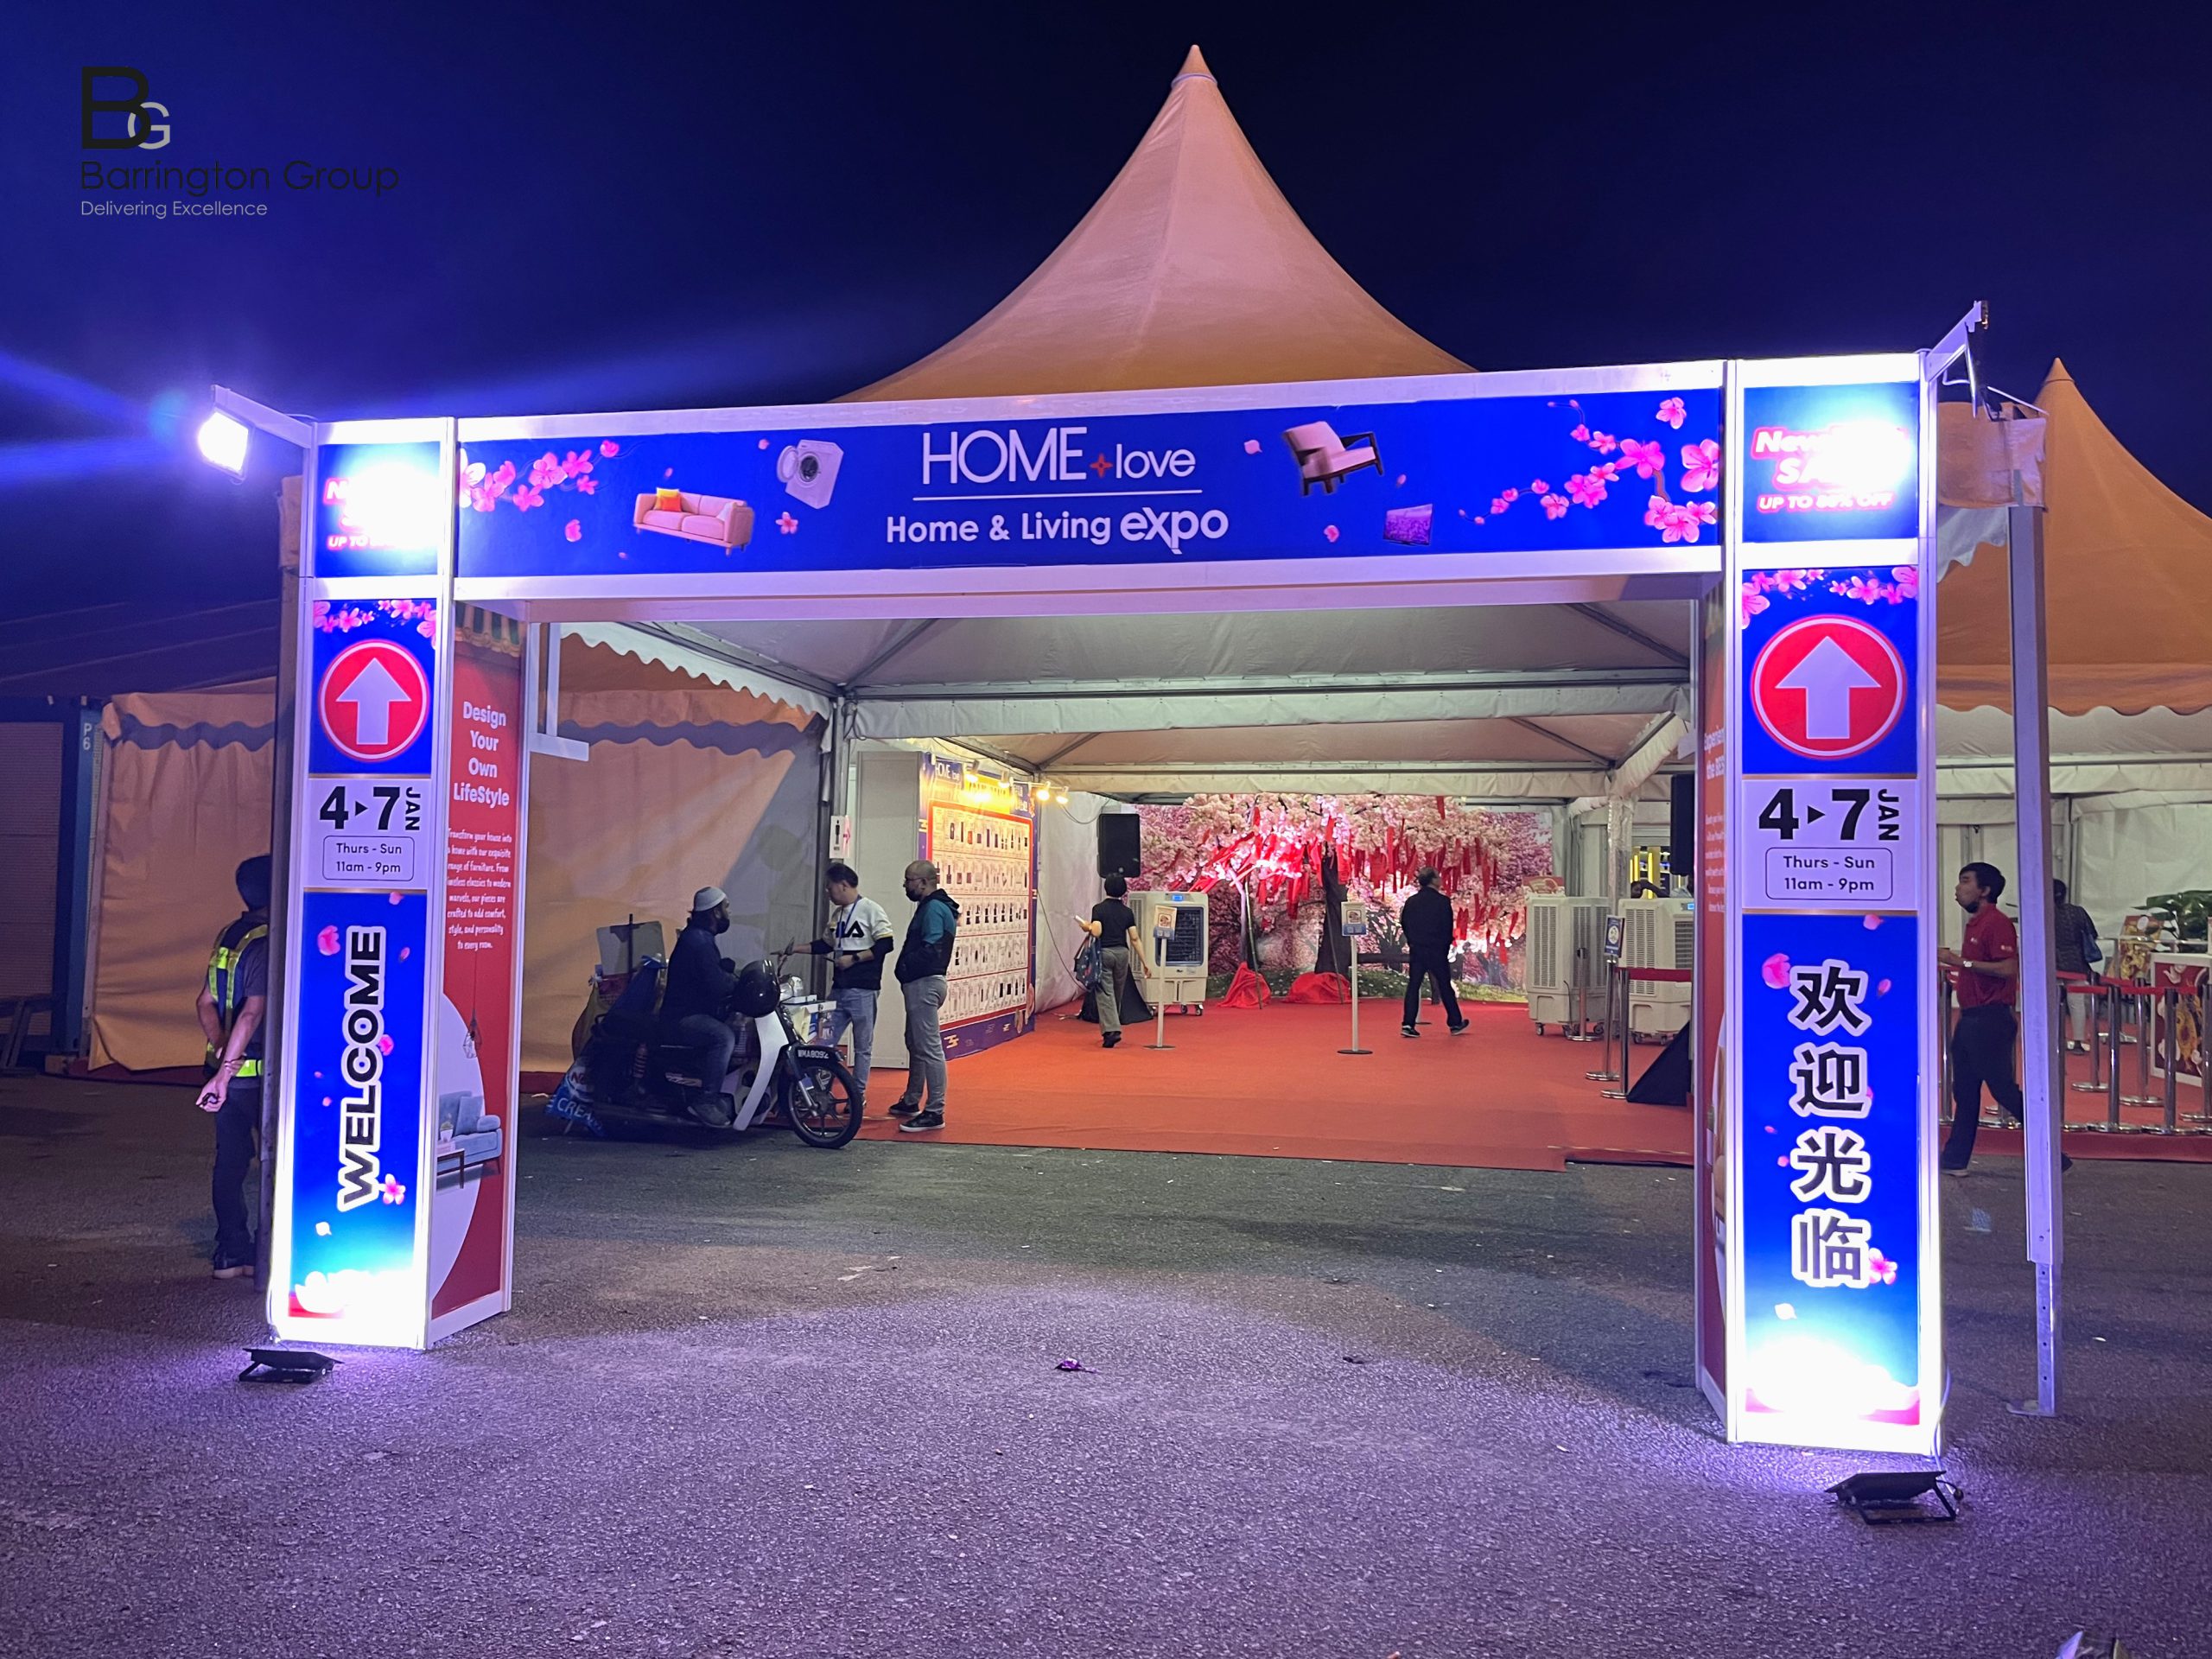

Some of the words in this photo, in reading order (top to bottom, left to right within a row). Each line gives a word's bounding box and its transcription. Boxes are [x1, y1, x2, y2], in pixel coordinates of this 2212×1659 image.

[922, 426, 1087, 485] HOME
[1116, 443, 1196, 479] love
[1759, 496, 1784, 509] UP
[1789, 495, 1813, 508] TO
[1857, 493, 1892, 507] OFF
[328, 536, 347, 547] UP
[350, 535, 368, 546] TO
[887, 516, 979, 543] Home
[989, 515, 1010, 541] &
[1021, 511, 1111, 545] Living
[1120, 507, 1229, 555] expo
[463, 701, 506, 729] Design
[470, 730, 499, 752] Your
[468, 757, 498, 778] Own
[320, 785, 349, 830] 4
[372, 786, 400, 830] 7
[404, 787, 421, 830] JAN
[454, 782, 510, 809] LifeStyle
[1758, 788, 1799, 840] 4
[1831, 788, 1870, 841] 7
[1878, 788, 1899, 841] JAN
[336, 842, 369, 855] Thurs
[380, 843, 402, 855] Sun
[336, 861, 364, 872] 11am
[375, 862, 401, 875] 9pm
[1783, 855, 1828, 868] Thurs
[1844, 855, 1875, 868] Sun
[1784, 877, 1823, 890] 11am
[1839, 878, 1874, 893] 9pm
[340, 928, 384, 1208] WELCOME
[1793, 963, 1867, 1283] 欢迎光临
